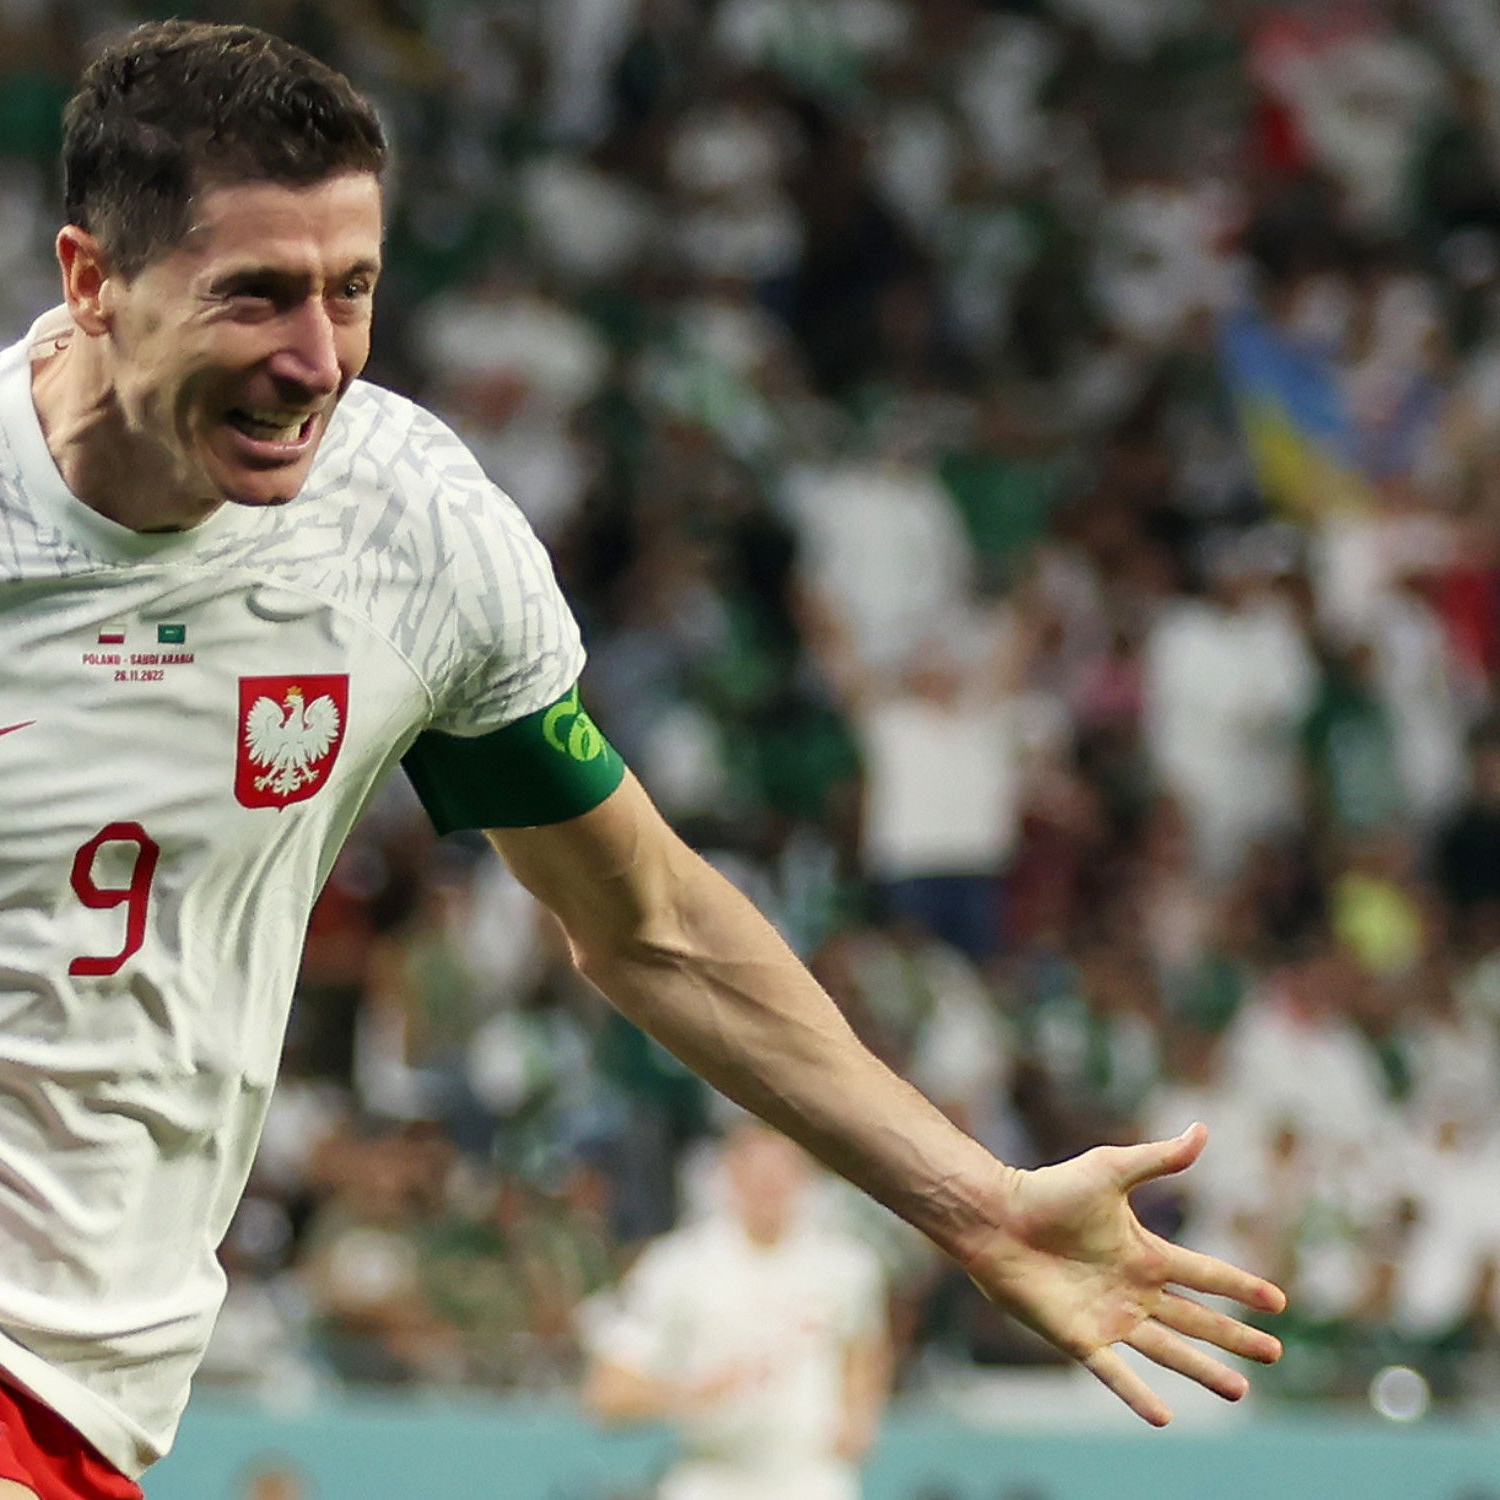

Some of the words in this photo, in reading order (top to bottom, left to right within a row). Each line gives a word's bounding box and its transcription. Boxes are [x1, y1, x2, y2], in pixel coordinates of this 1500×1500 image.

[82, 654, 121, 665] POLAND
[130, 653, 159, 665] SAUDI
[160, 653, 195, 665] ARABIA
[114, 670, 164, 681] 26.11.2022
[69, 821, 160, 976] 9
